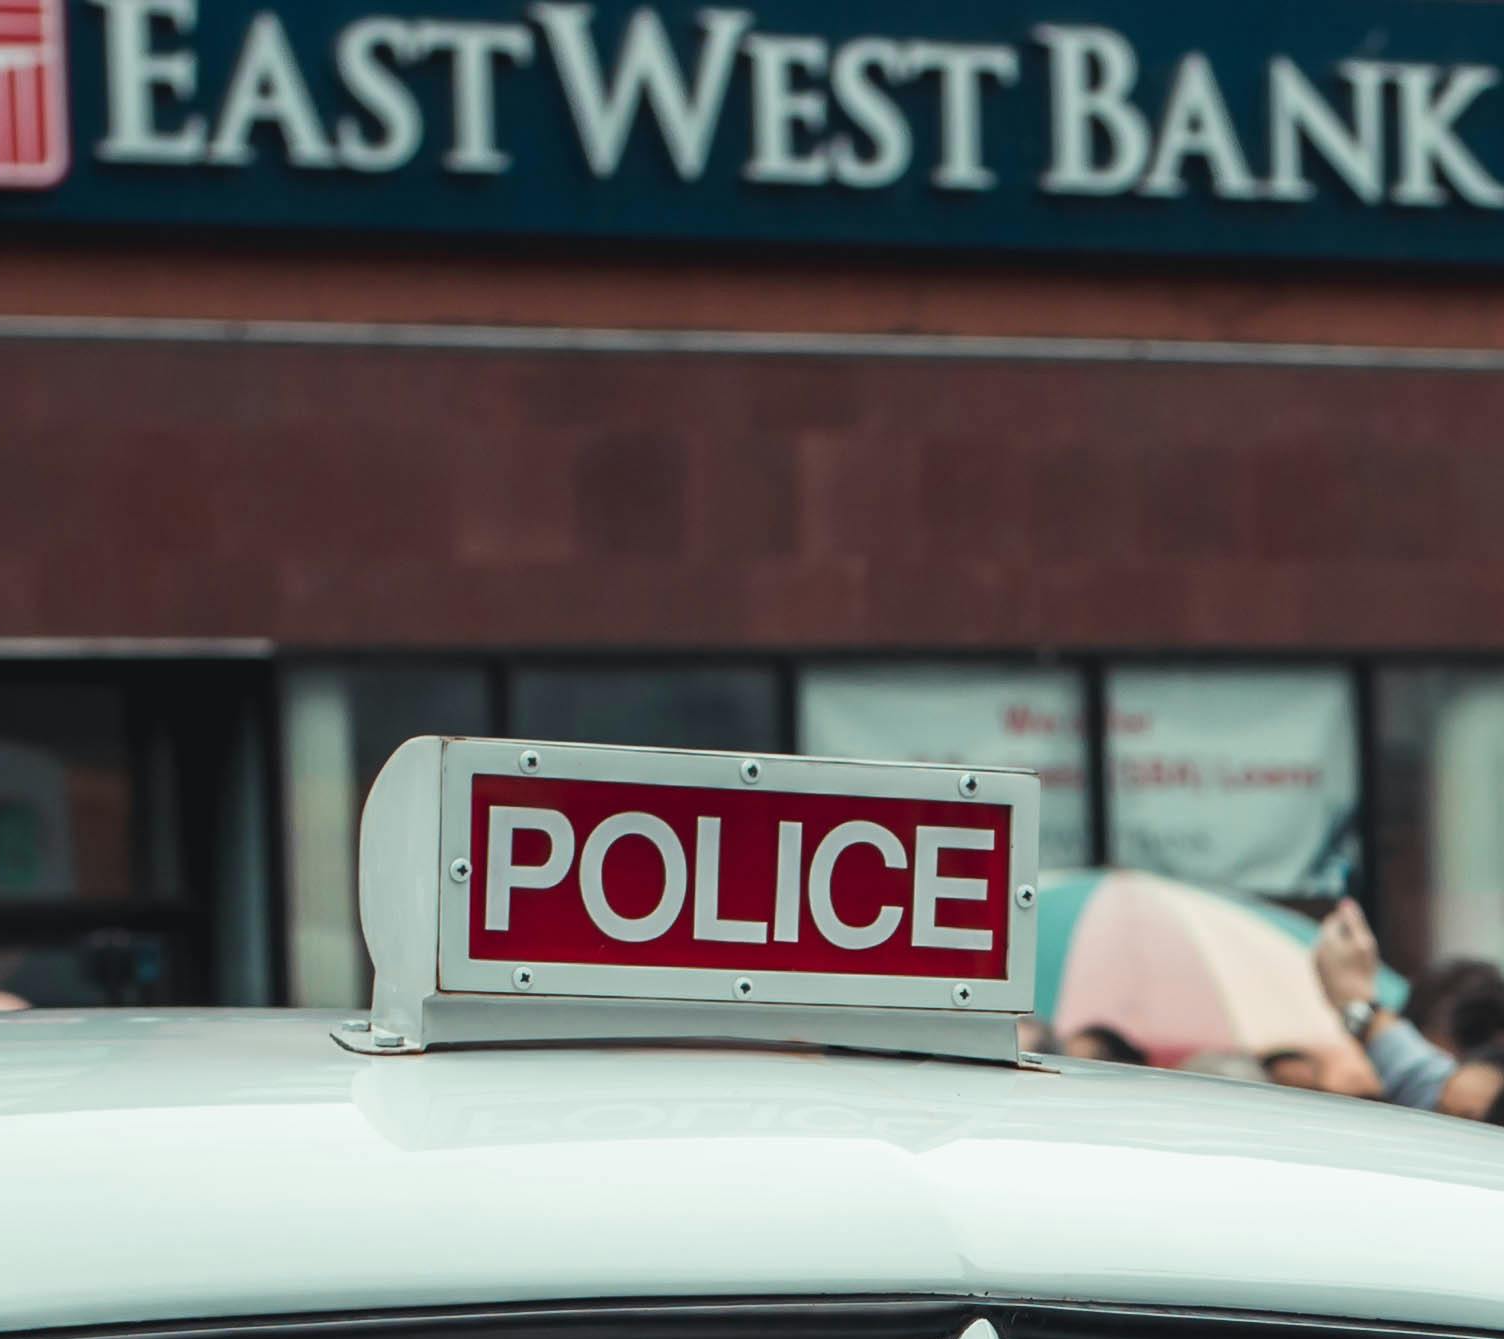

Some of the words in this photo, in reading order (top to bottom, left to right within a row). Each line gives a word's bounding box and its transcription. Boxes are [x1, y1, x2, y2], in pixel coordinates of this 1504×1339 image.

[94, 0, 533, 172] EAST
[534, 2, 1018, 188] WEST
[484, 805, 995, 952] POLICE
